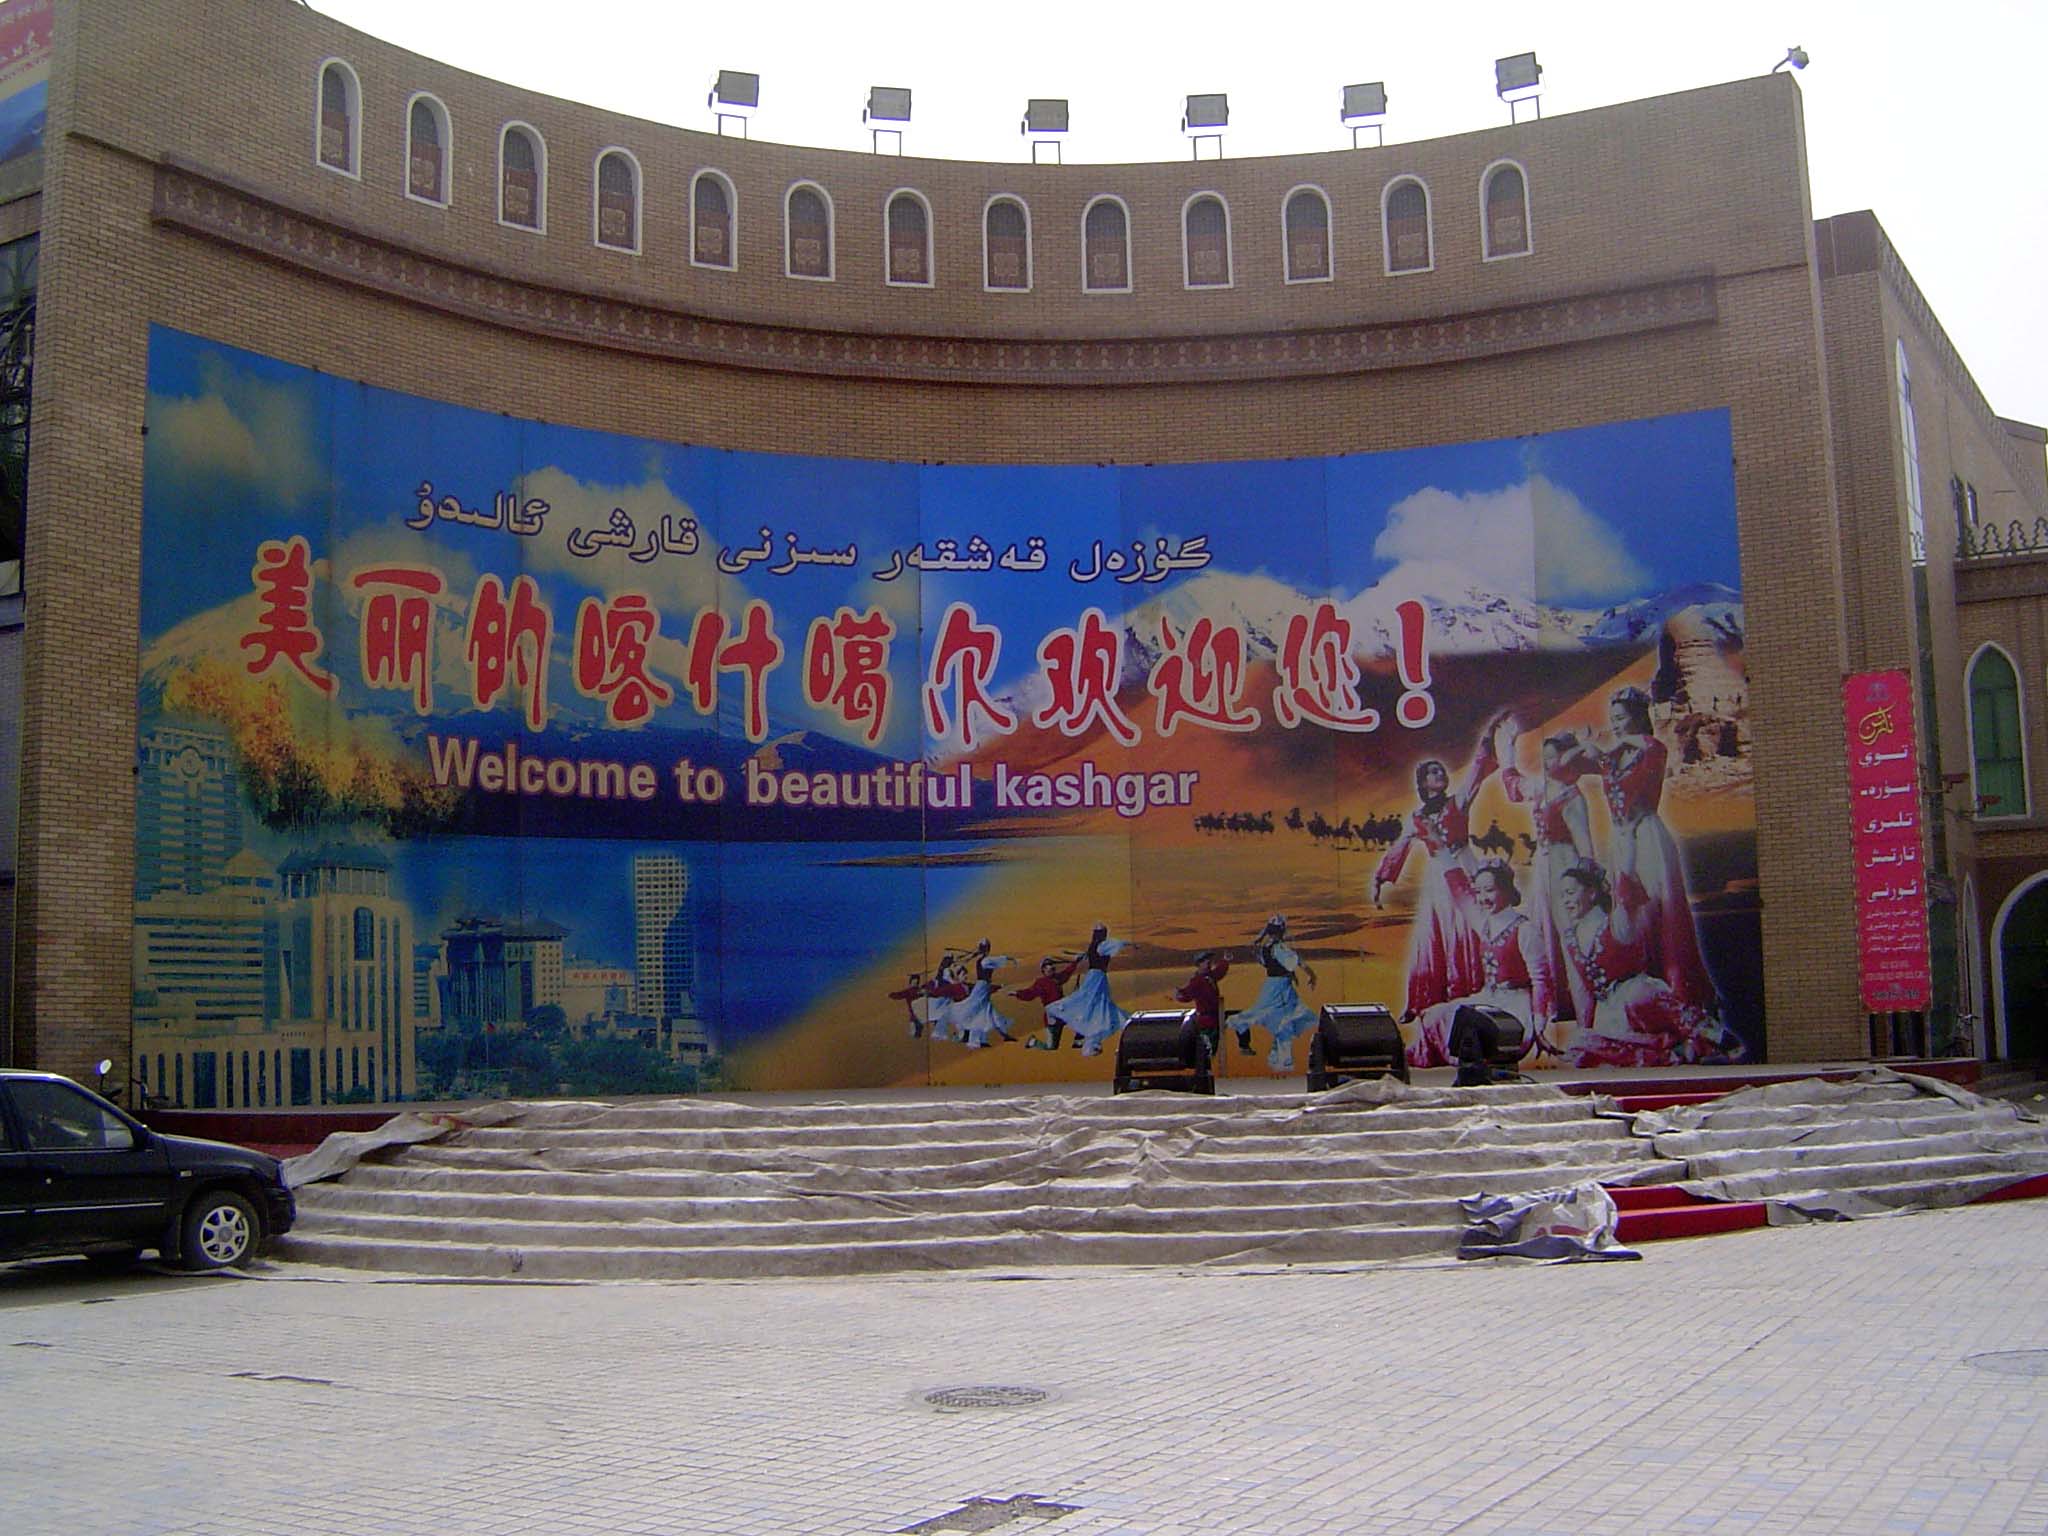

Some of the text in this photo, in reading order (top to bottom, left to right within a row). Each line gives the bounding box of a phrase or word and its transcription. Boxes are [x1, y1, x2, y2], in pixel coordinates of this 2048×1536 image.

[406, 481, 551, 536] ئالىدۇ
[567, 507, 701, 564] قارشى
[871, 535, 1049, 583] قەشقەر
[1068, 535, 1214, 584] گۈزەل
[426, 735, 1199, 818] Welcome to beautiful kashgar
